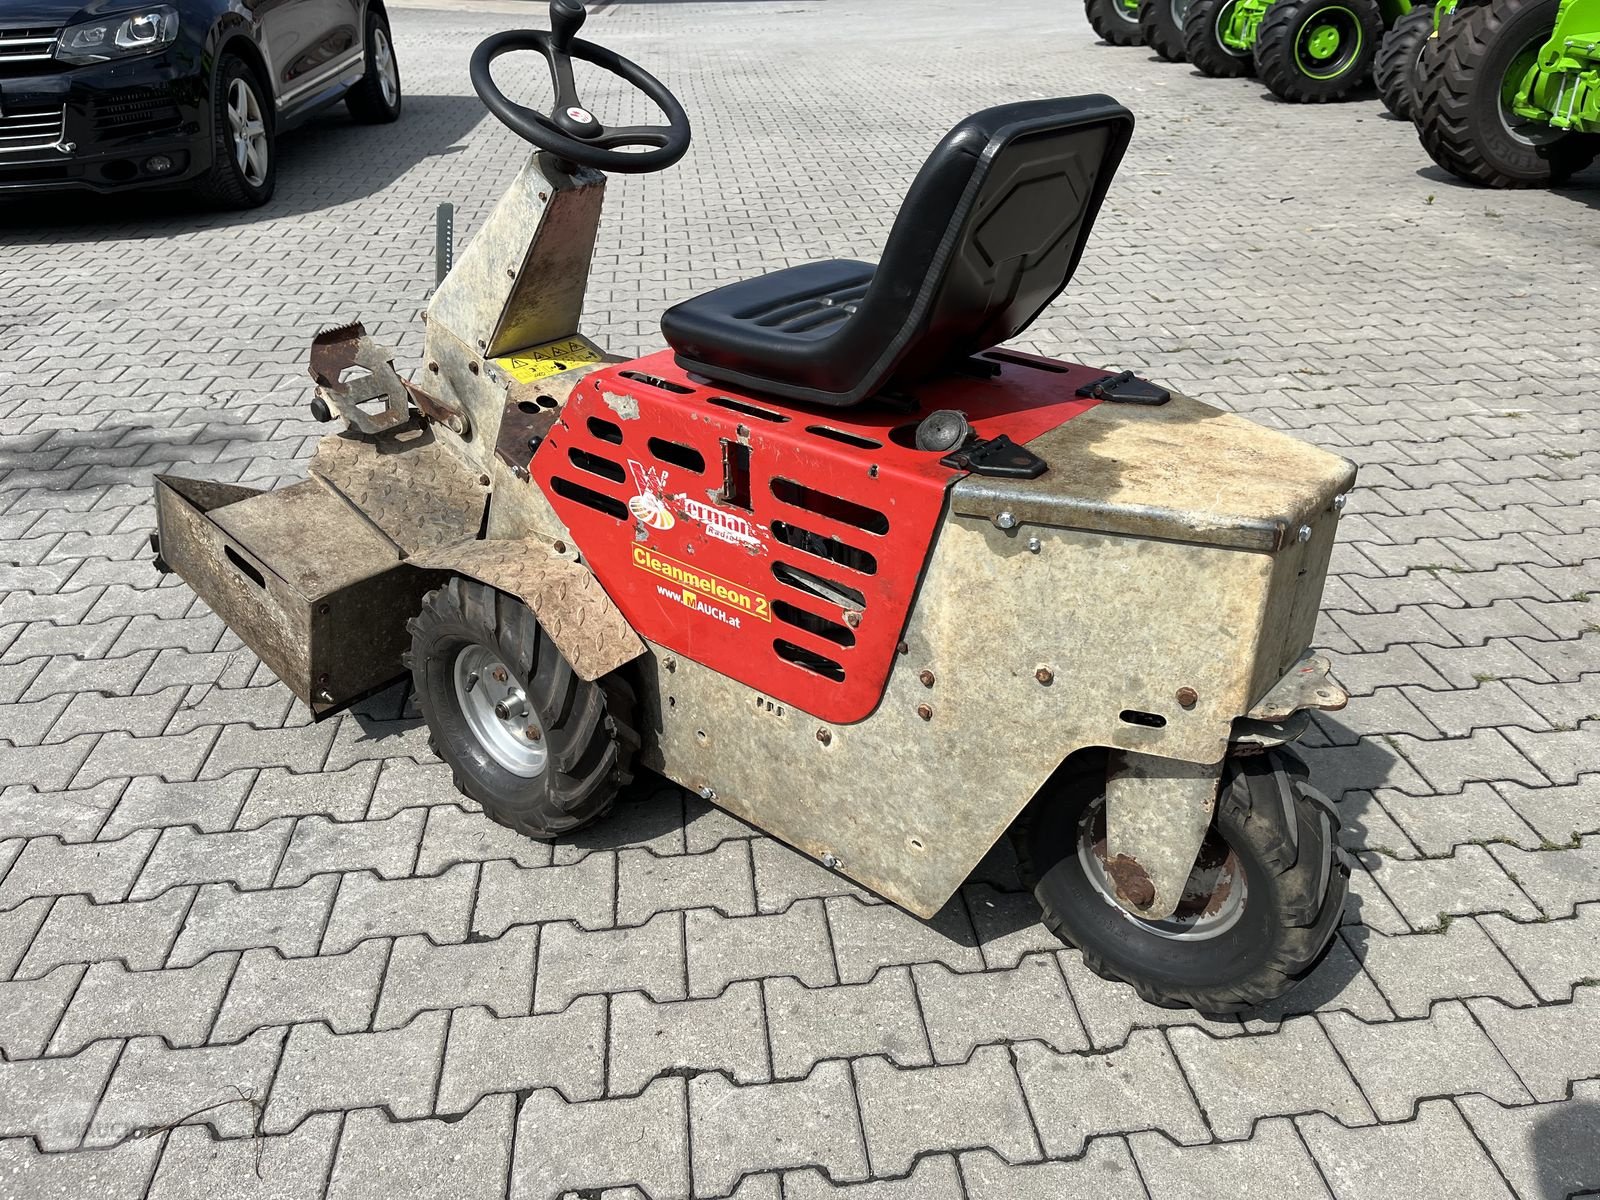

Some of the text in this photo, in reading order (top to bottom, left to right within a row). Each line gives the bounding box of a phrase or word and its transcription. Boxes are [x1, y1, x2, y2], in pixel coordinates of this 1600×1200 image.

[633, 548, 768, 616] Cleanmeleon 2
[656, 585, 741, 628] www.MAUCH.at
